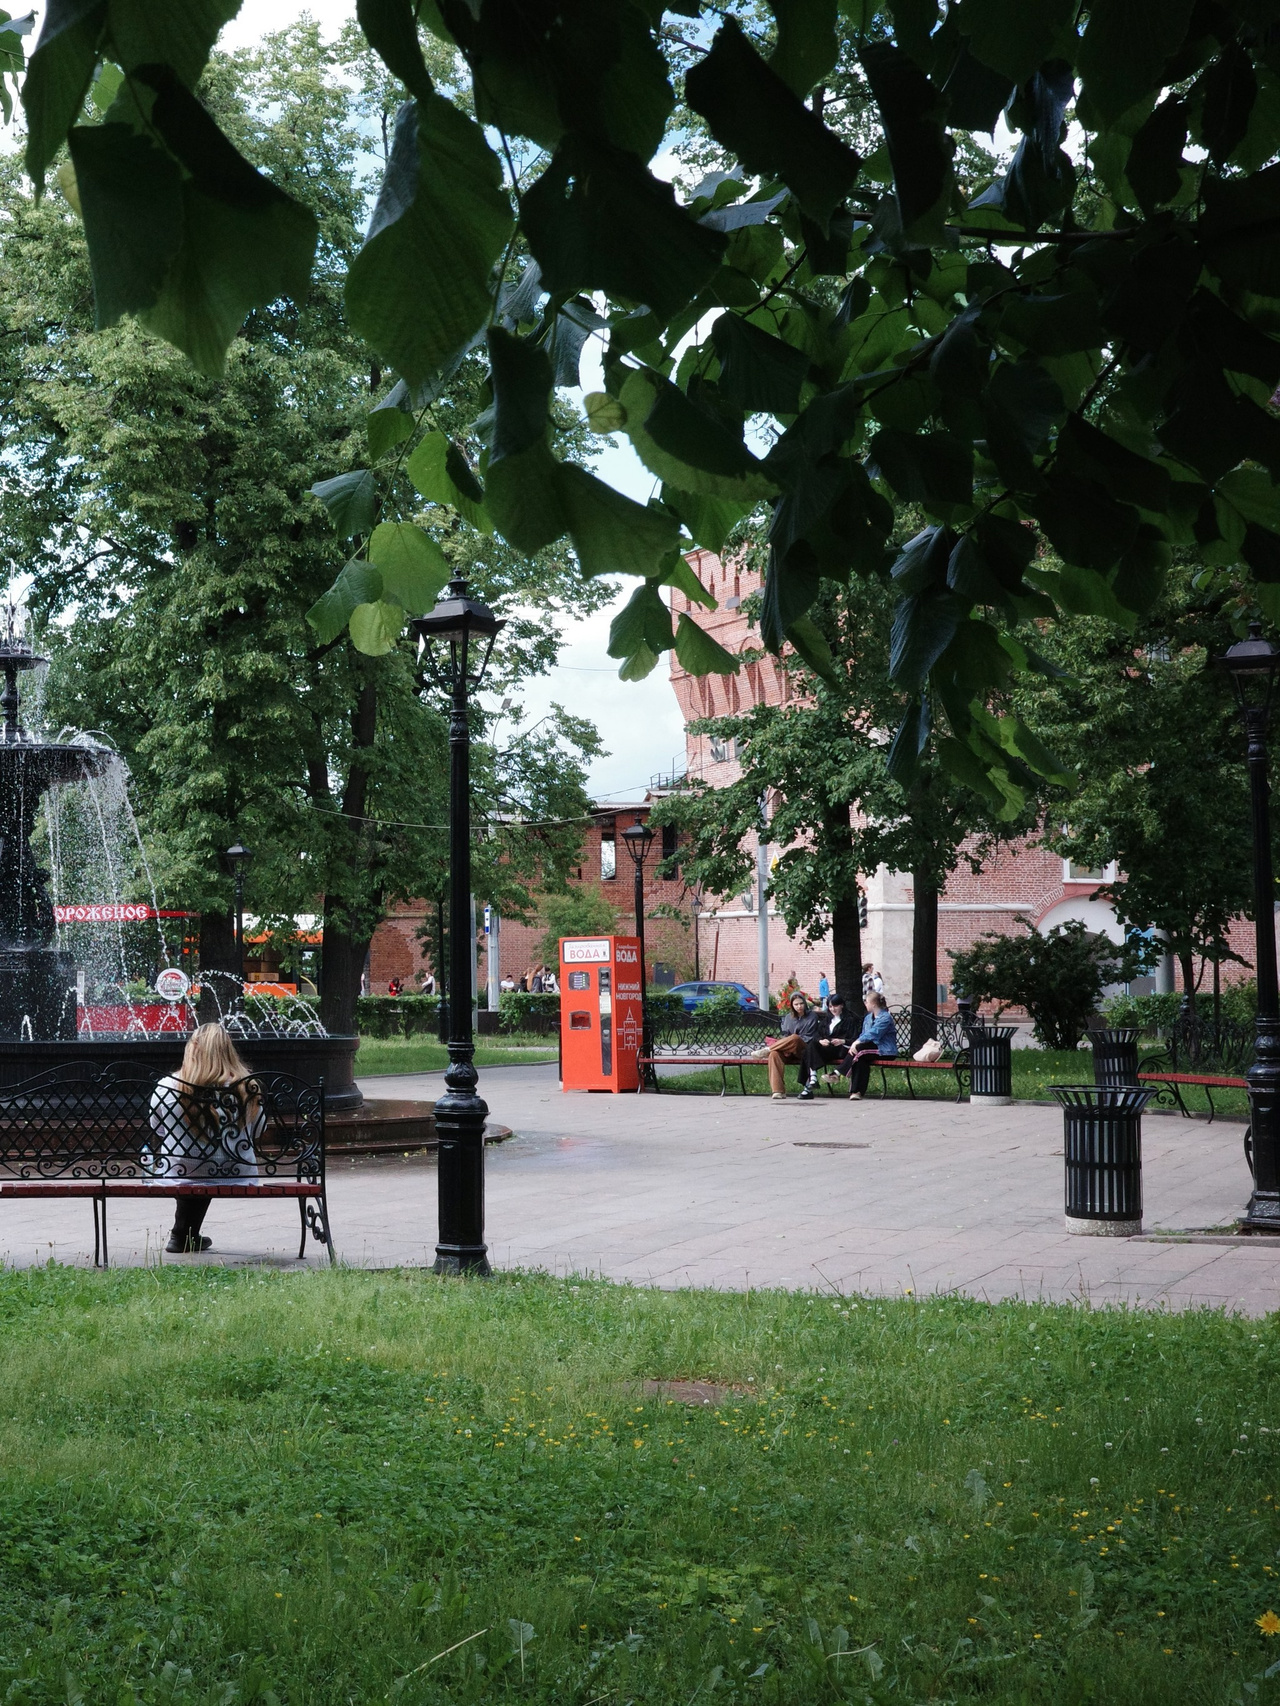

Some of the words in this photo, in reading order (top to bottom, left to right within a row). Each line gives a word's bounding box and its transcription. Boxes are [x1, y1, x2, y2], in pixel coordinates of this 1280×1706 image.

[54, 906, 148, 920] ОРОЖЕНОЕ
[570, 949, 600, 959] ВОДА
[616, 950, 637, 962] ВОДА
[618, 982, 640, 990] НИЖНИЙ
[616, 992, 642, 1001] НОВГОРОД
